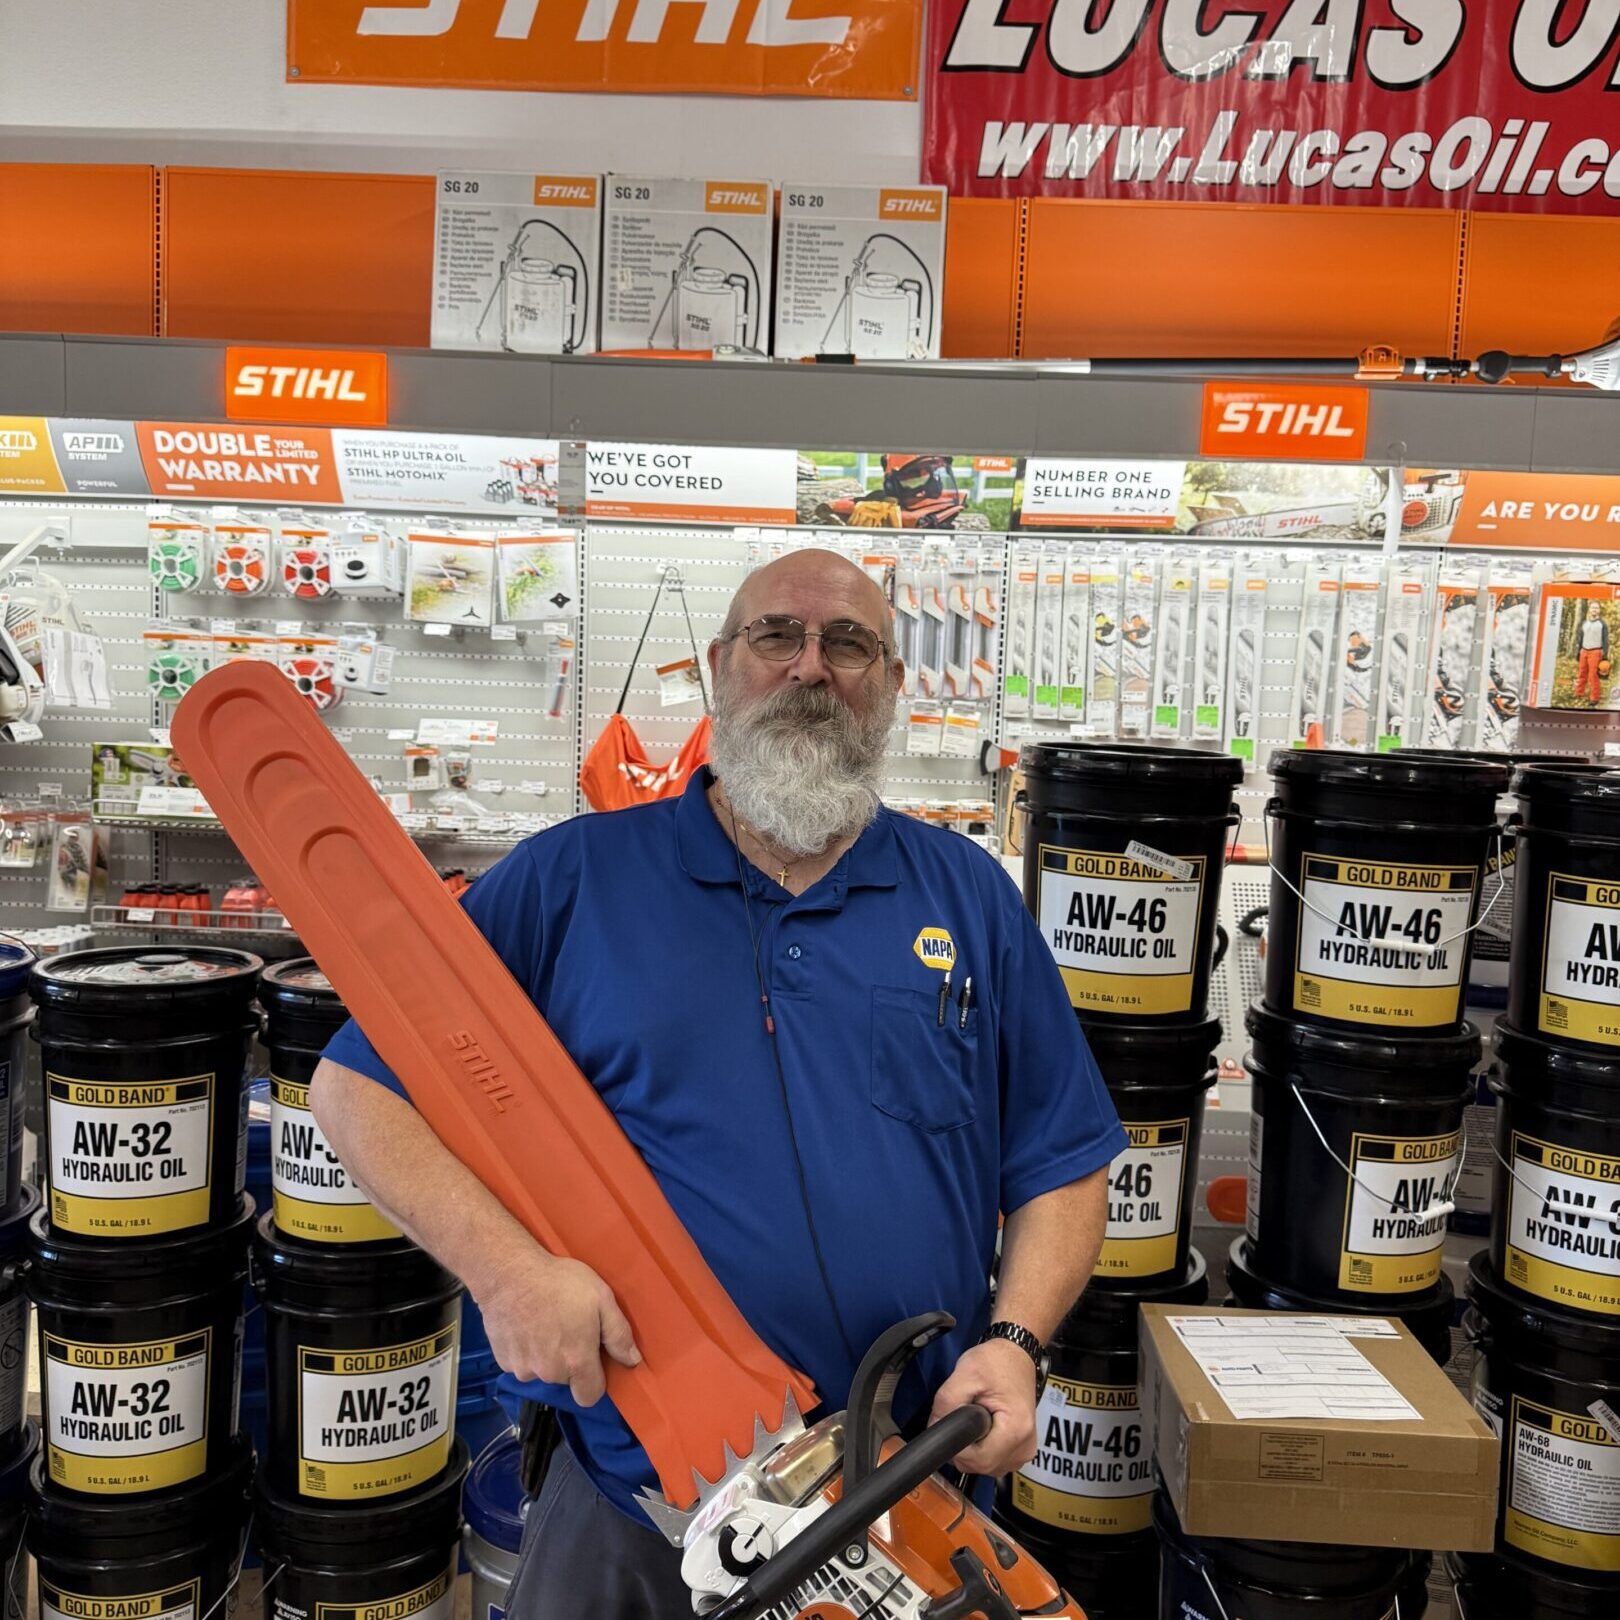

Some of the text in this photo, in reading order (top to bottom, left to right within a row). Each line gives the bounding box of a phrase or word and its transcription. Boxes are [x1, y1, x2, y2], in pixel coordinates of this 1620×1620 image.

[444, 180, 480, 194] SG 20
[538, 185, 592, 199] STIHL
[615, 186, 650, 200] SG 20
[709, 191, 762, 206] STIHL
[789, 194, 824, 208] SG 20
[884, 199, 937, 213] STIHL
[234, 365, 367, 401] STIHL
[1217, 402, 1355, 437] STIHL
[153, 430, 273, 457] DOUBLE
[273, 439, 304, 450] YOUR
[275, 448, 319, 459] LIMITED
[68, 453, 107, 461] SYSTEM
[344, 448, 467, 463] STIHL HP ULTRA OIL
[588, 451, 693, 469] WE'VE GOT
[978, 458, 1009, 469] STIHL
[157, 457, 321, 485] WARRANTY
[347, 468, 446, 481] STIHL MOTOMIX
[589, 471, 723, 490] YOU COVERED
[1034, 469, 1153, 483] NUMBER ONE
[1032, 485, 1171, 499] SELLING BRAND
[1480, 500, 1535, 519] ARE
[1543, 502, 1600, 521] YOU
[1276, 514, 1323, 529] STIHL
[1075, 857, 1116, 875] GOLD
[1347, 866, 1441, 889] GOLD BAND
[1066, 891, 1167, 934] AW-46
[1335, 901, 1442, 945] AW-46
[921, 938, 954, 960] NAPA
[1053, 928, 1176, 958] HYDRAULIC OIL
[1319, 939, 1448, 970] HYDRAULIC OIL
[1101, 994, 1114, 1003] GAL
[447, 1030, 514, 1114] STIHL
[75, 1087, 165, 1104] GOLD BAND
[73, 1121, 172, 1158] AW-32
[1403, 1143, 1437, 1160] GOLD
[63, 1157, 187, 1182] HYDRAULIC OIL
[275, 1156, 345, 1188] HYDRAULIC
[1551, 1151, 1595, 1175] GOLD
[1108, 1163, 1153, 1198] -46
[1140, 1202, 1162, 1221] OIL
[110, 1219, 123, 1227] GAL
[1577, 1291, 1591, 1301] GAL
[74, 1346, 164, 1366] GOLD BAND
[343, 1354, 386, 1372] GOLD
[389, 1344, 427, 1368] BAND
[71, 1379, 170, 1417] AW-32
[336, 1375, 431, 1424] AW-32
[1096, 1389, 1138, 1407] BAND
[60, 1413, 185, 1442] HYDRAULIC OIL
[321, 1407, 439, 1448] HYDRAULIC OIL
[1044, 1414, 1141, 1458] AW-46
[1519, 1427, 1550, 1448] AW-68
[1561, 1419, 1607, 1442] GOLD
[1518, 1439, 1593, 1471] HYDRAULIC OIL
[1032, 1449, 1150, 1482] HYDRAULIC OIL
[108, 1477, 121, 1485] GAL
[65, 1598, 151, 1618] GOLD BAND
[364, 1583, 441, 1620] GOLD BAND
